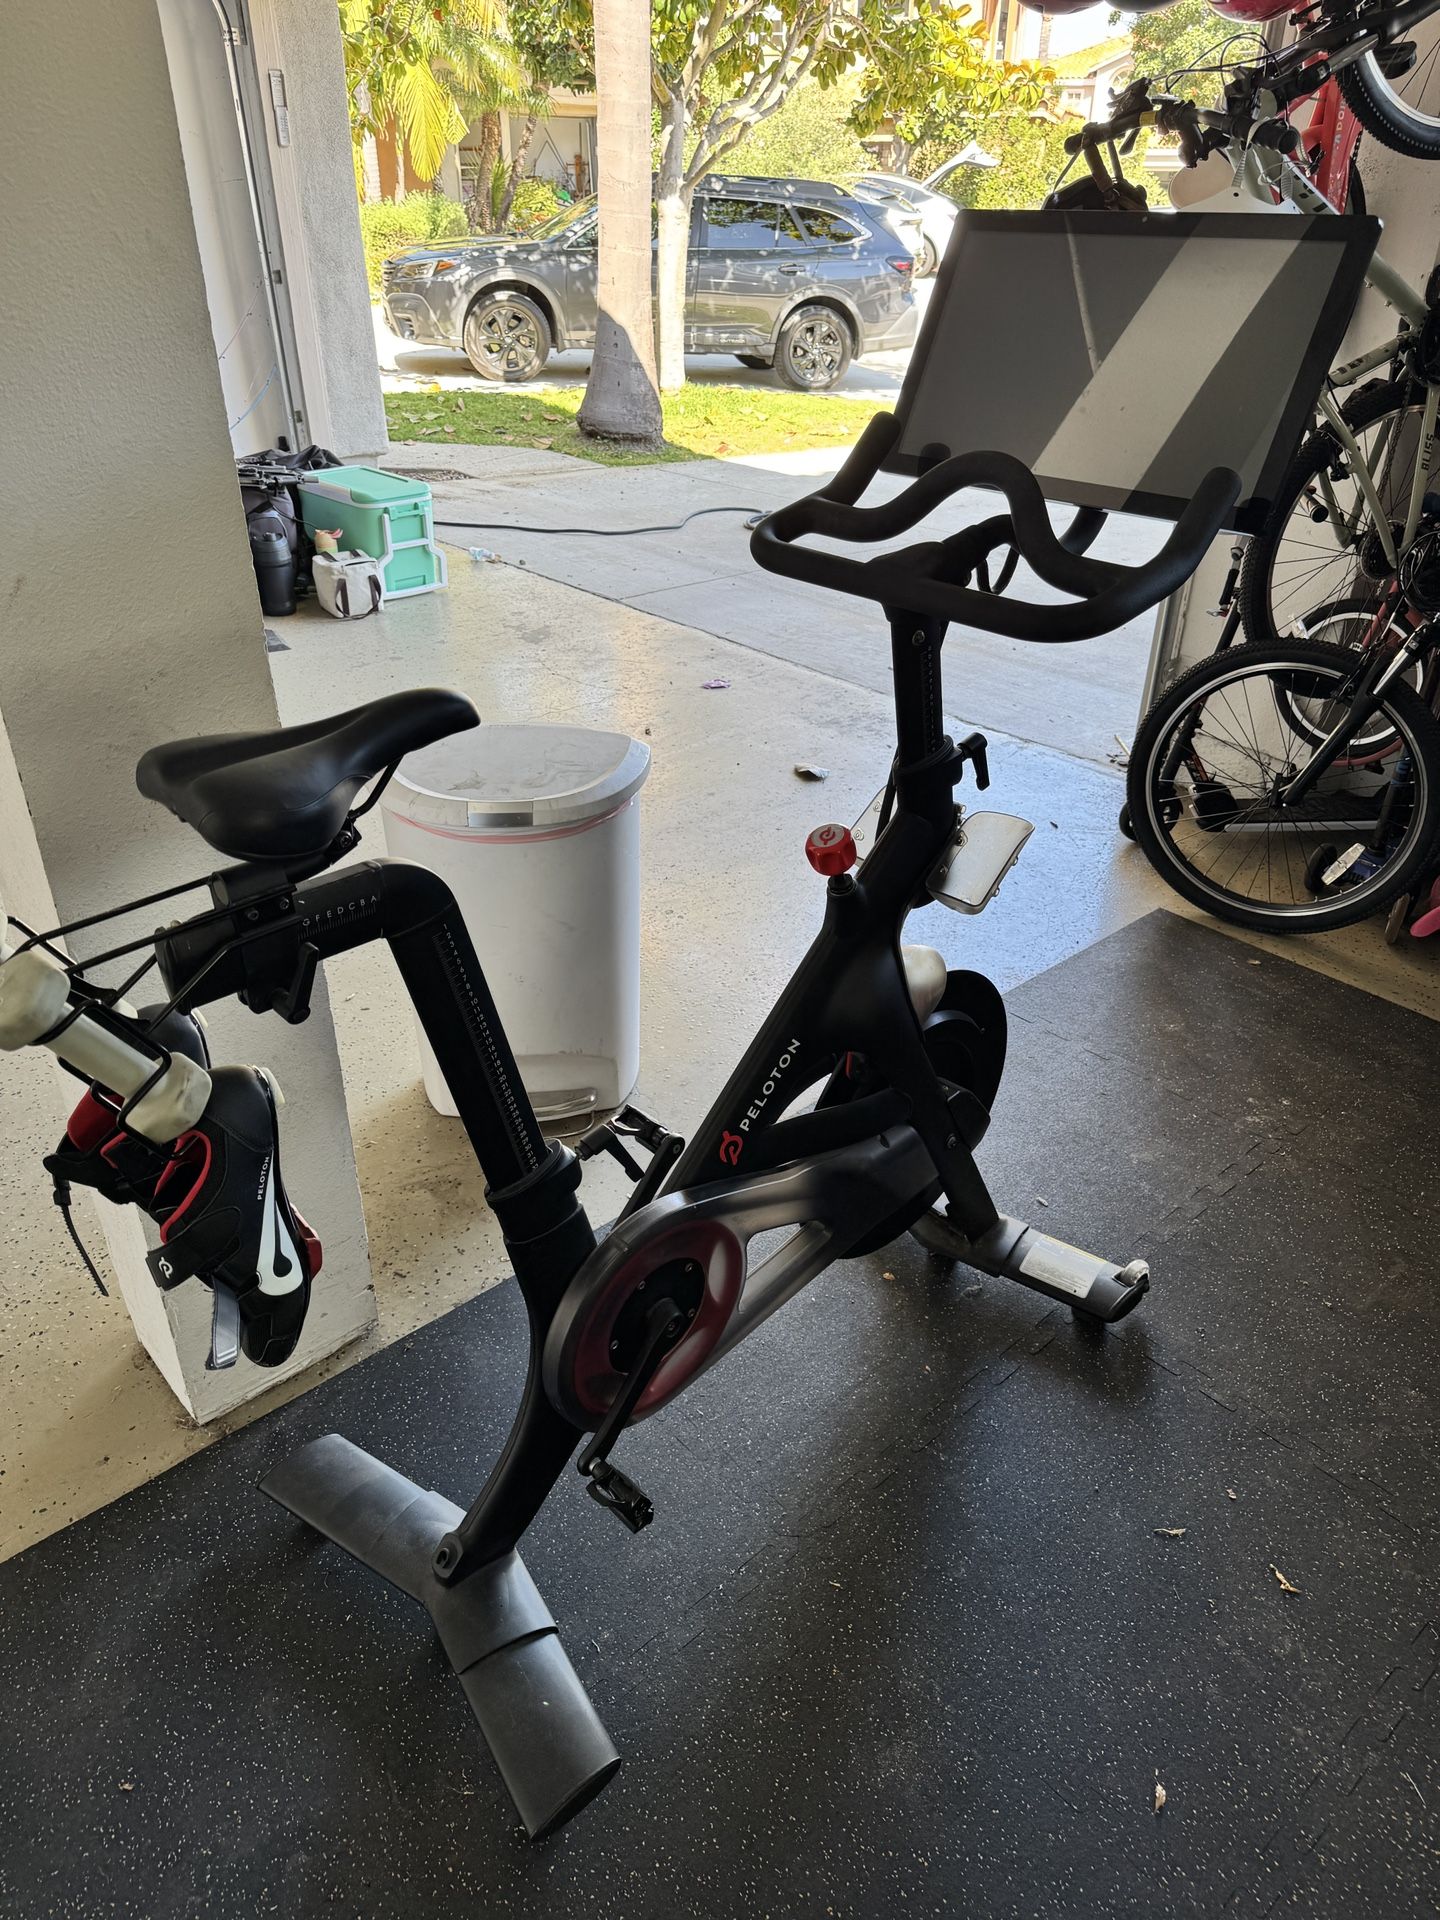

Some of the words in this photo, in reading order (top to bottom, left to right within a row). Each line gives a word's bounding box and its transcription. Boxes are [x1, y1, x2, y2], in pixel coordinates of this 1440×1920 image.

[1421, 432, 1435, 471] BLISS
[315, 914, 320, 922] F
[326, 910, 332, 918] E
[337, 906, 344, 915] D
[348, 902, 355, 910] C
[360, 898, 366, 906] B
[371, 895, 377, 903] A
[739, 1038, 801, 1132] PELOTON
[257, 1156, 270, 1201] PELOTON
